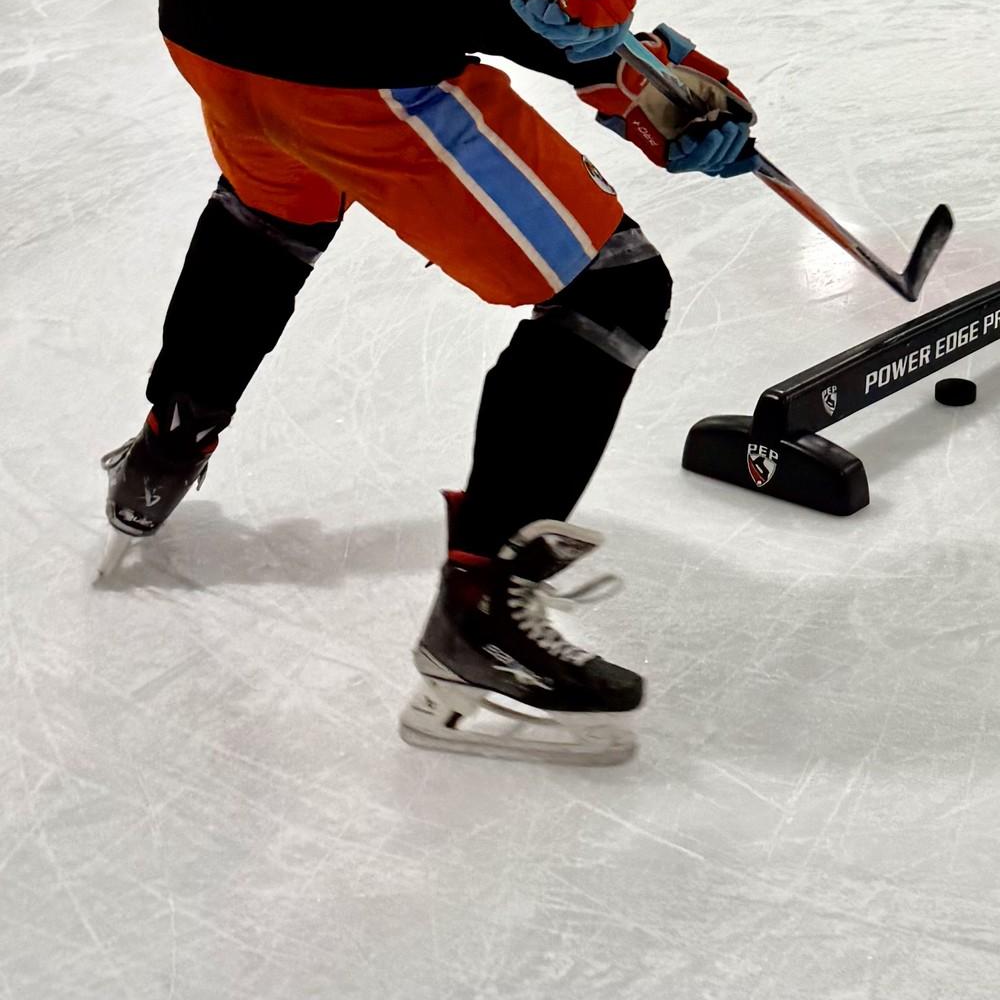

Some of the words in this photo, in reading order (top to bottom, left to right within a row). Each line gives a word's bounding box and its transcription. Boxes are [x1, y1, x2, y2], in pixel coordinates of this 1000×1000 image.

[865, 344, 931, 394] POWER
[935, 320, 979, 360] EDGE
[747, 443, 779, 460] PEP
